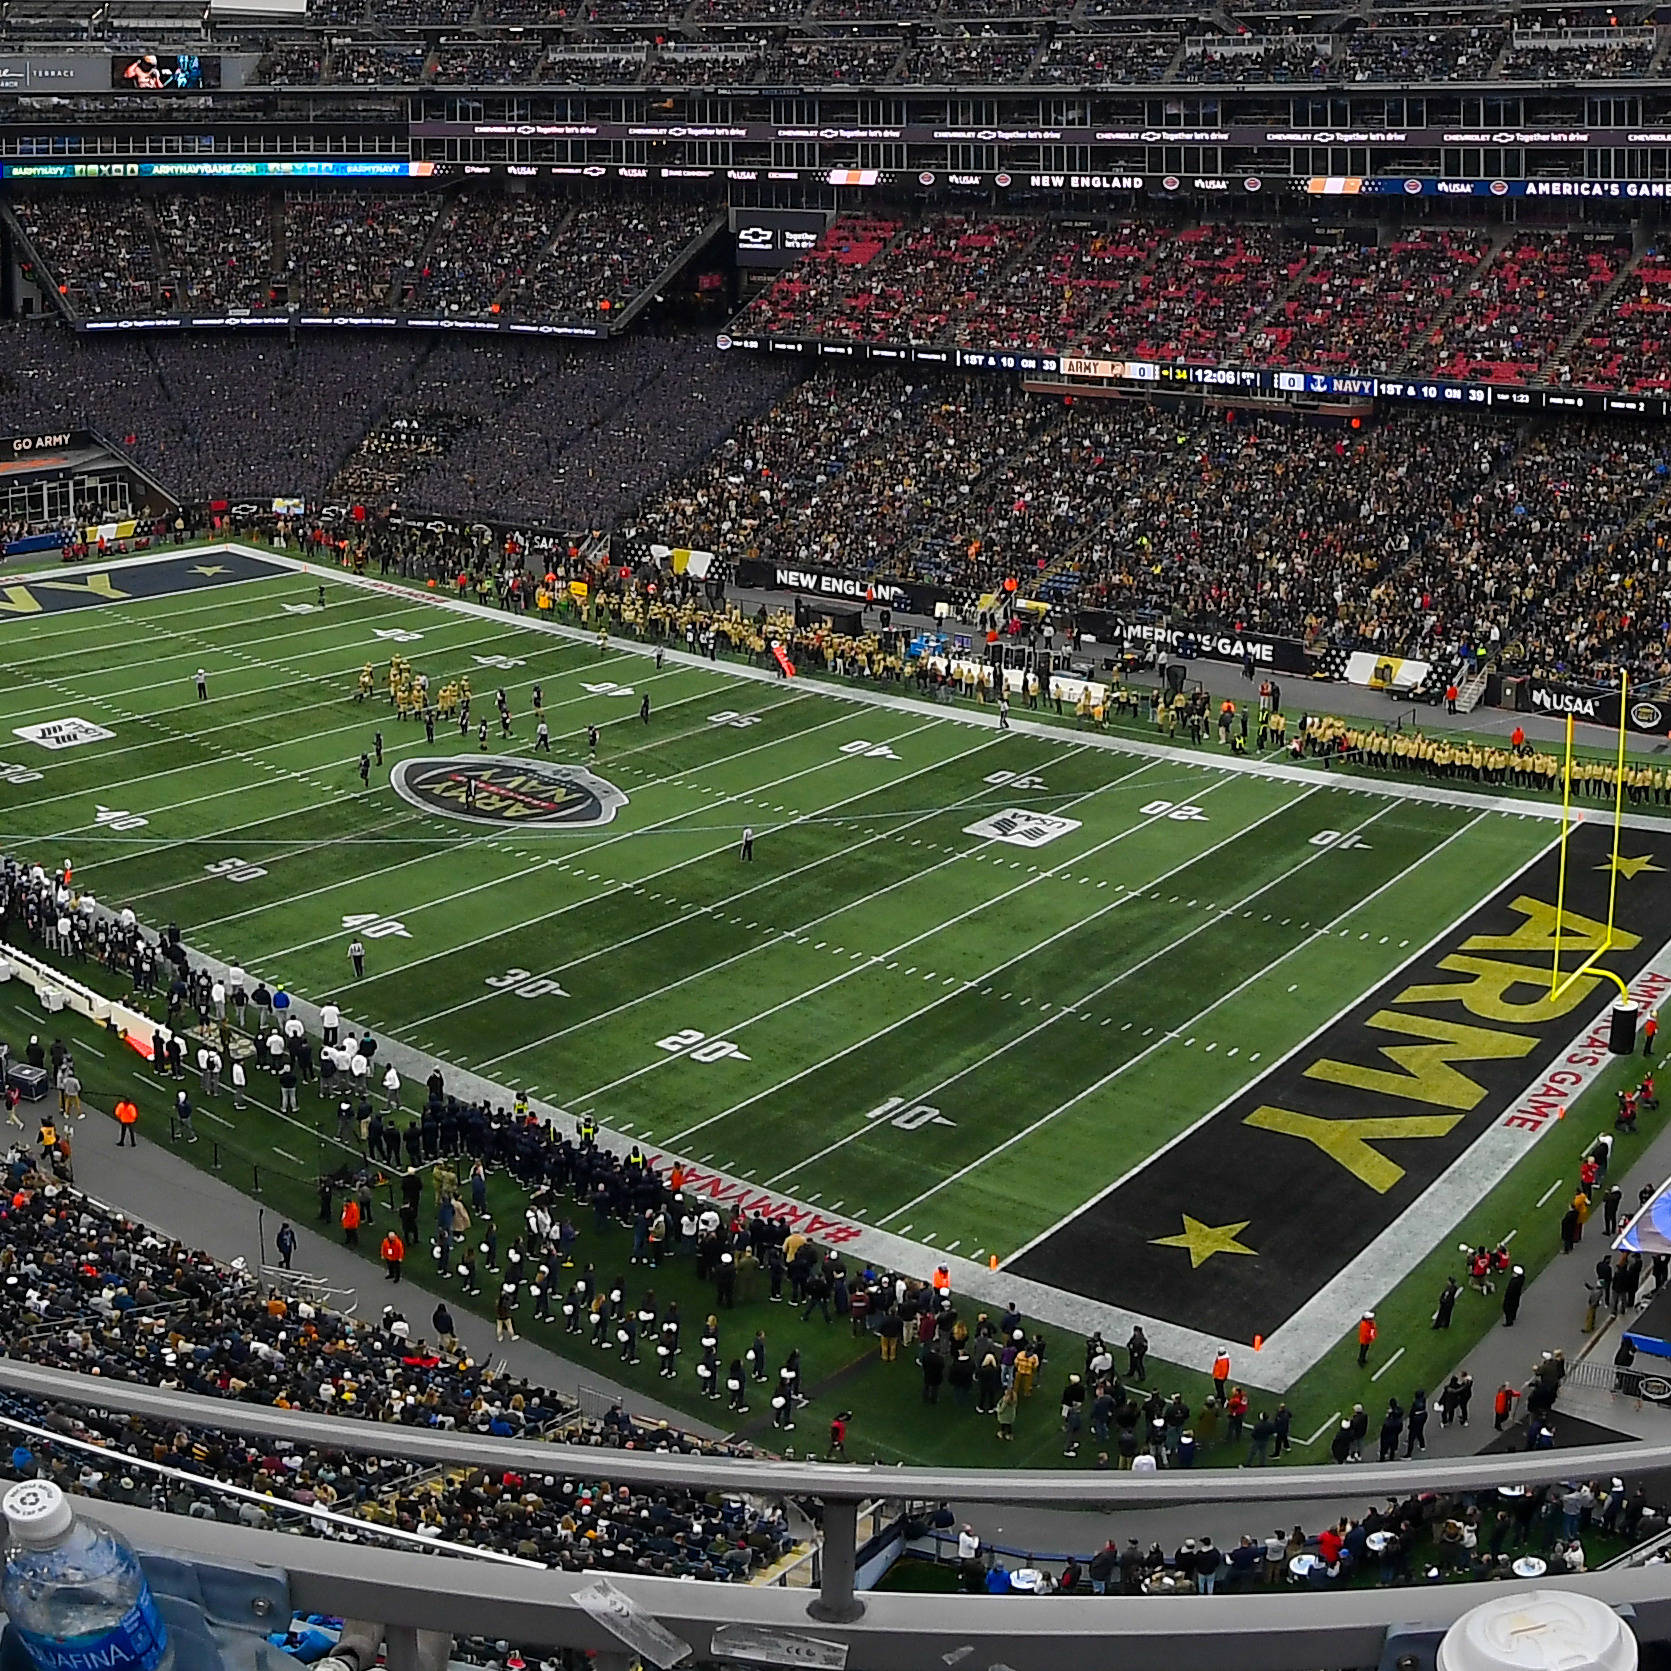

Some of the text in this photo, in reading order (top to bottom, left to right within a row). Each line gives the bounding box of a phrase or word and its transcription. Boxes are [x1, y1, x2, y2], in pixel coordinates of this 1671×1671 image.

[1031, 176, 1143, 189] NEW ENGLAND
[1525, 183, 1620, 196] AMERICA'S
[963, 354, 984, 366] 1ST
[1043, 359, 1057, 370] 39
[1067, 360, 1146, 377] ARMY 0
[1175, 369, 1235, 384] 34 12:06
[1288, 378, 1371, 393] 0 NAVY
[1380, 384, 1404, 396] 1ST
[1422, 385, 1437, 398] 10
[1444, 388, 1462, 399] ON
[1468, 389, 1485, 402] 39
[13, 433, 70, 451] GO ARMY
[775, 569, 819, 591] NEW
[1552, 691, 1596, 717] USAA
[203, 856, 268, 884] 50
[341, 912, 406, 939] 40
[484, 967, 561, 999] 30
[654, 1028, 739, 1064] 20
[1243, 894, 1645, 1195] ARMY
[1505, 1070, 1582, 1132] GAME
[864, 1096, 941, 1130] 10
